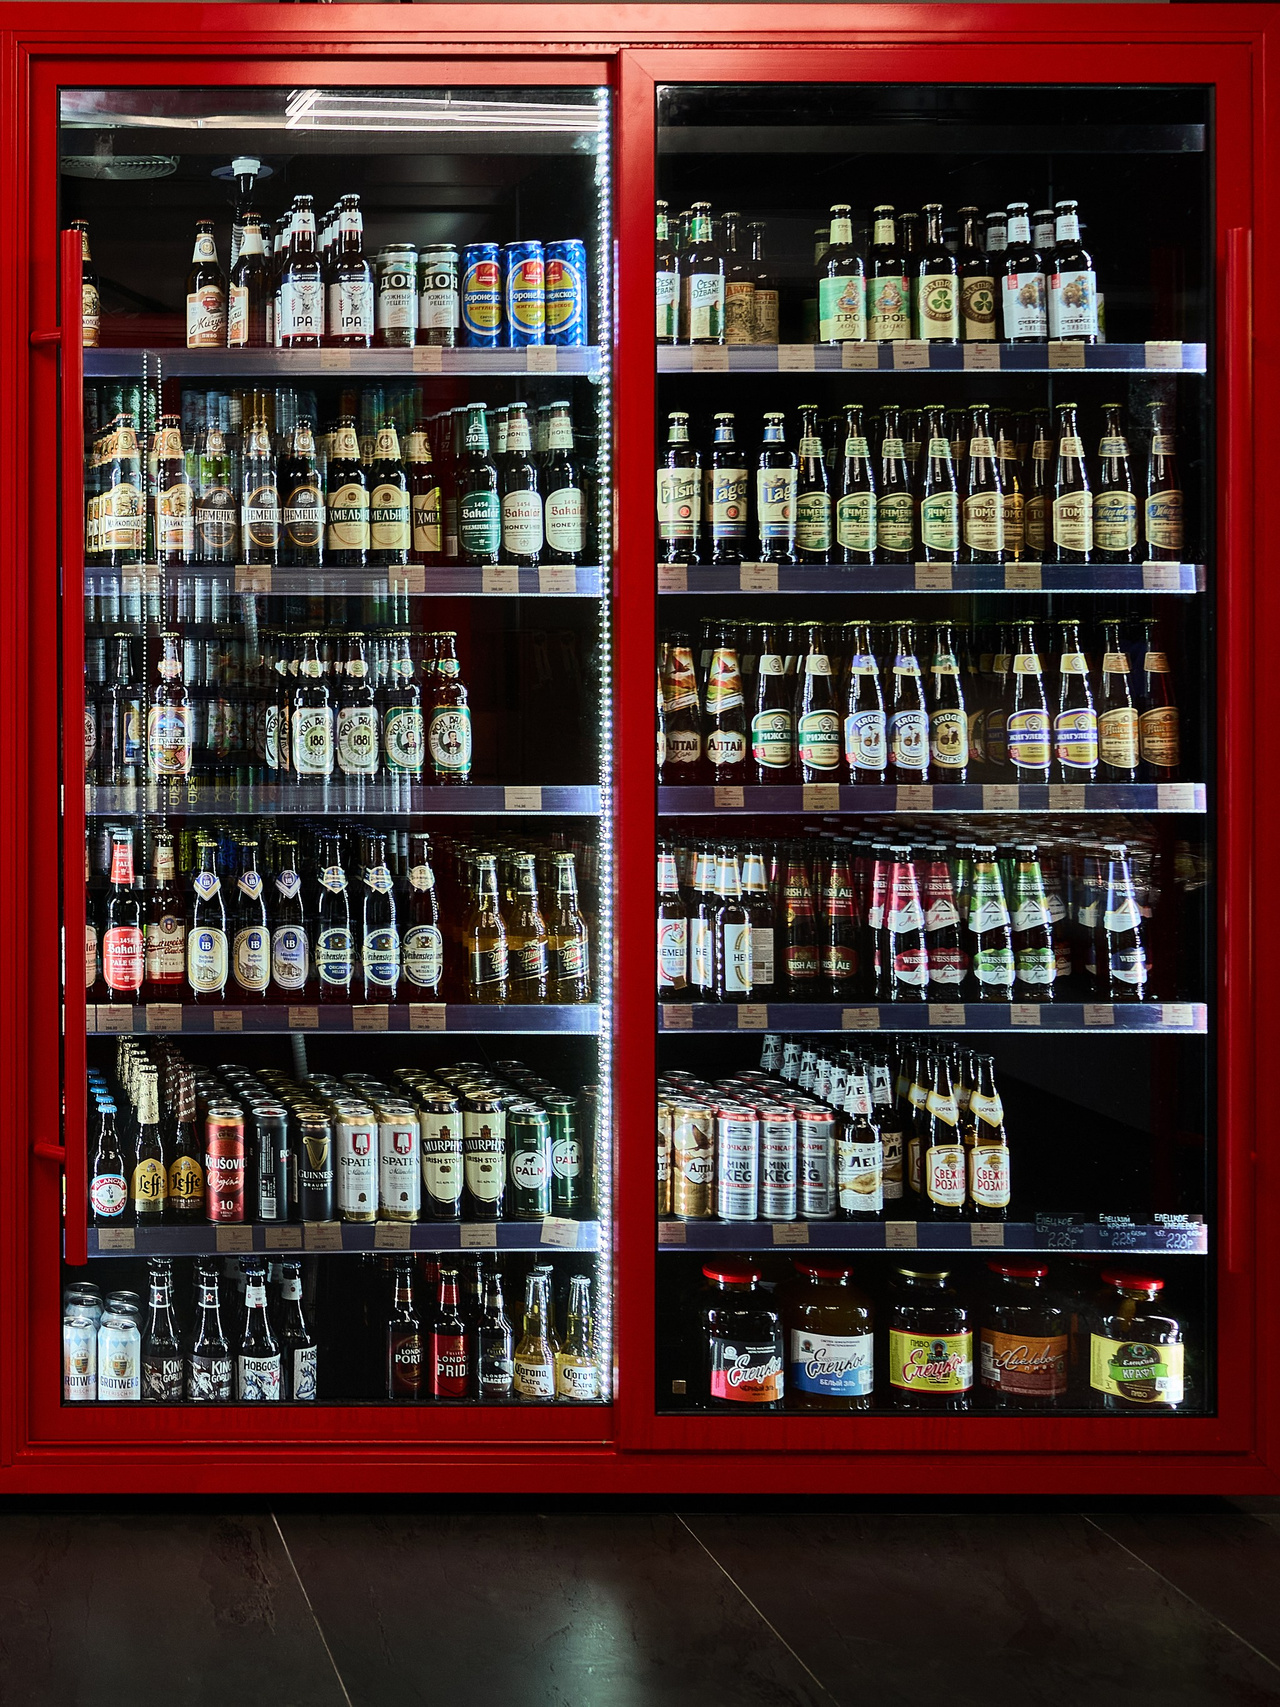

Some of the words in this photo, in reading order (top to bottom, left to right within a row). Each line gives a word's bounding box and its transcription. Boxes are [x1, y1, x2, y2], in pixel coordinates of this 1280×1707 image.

[292, 315, 313, 327] IPA
[342, 317, 362, 328] IPA
[353, 735, 370, 746] 1881
[707, 738, 744, 751] АЛТАЙ
[839, 888, 852, 897] ALE
[201, 940, 211, 951] HB
[250, 940, 260, 950] HB
[285, 939, 296, 949] HB
[837, 960, 850, 969] ALE
[515, 1165, 545, 1176] PALM
[727, 1161, 750, 1169] MINI
[768, 1161, 790, 1169] MINI
[298, 1169, 333, 1178] GUINNESS
[725, 1169, 751, 1181] KEG
[764, 1168, 793, 1182] KEG
[139, 1173, 166, 1197] Leffe
[172, 1171, 200, 1196] Leffe
[219, 1200, 234, 1209] 10
[163, 1360, 183, 1372] KING
[211, 1360, 231, 1372] KING
[806, 1349, 864, 1376] Елецкое
[1122, 1367, 1157, 1380] КРАФТ
[520, 1377, 540, 1386] Extra
[572, 1379, 592, 1388] Extra
[1130, 1390, 1148, 1398] ПИВО
